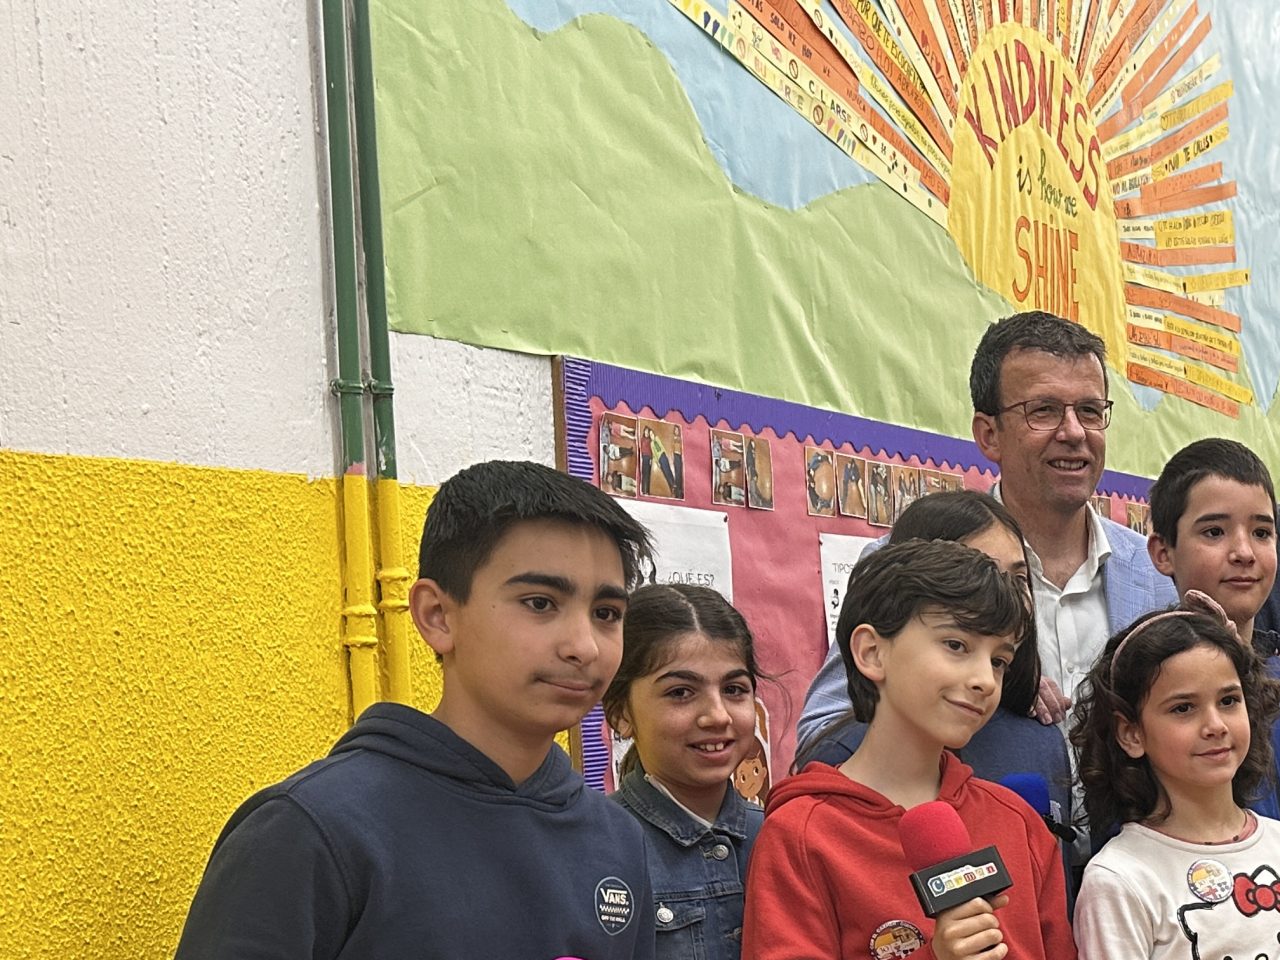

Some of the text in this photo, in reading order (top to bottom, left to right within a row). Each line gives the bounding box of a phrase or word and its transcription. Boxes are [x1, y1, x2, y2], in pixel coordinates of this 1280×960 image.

[964, 38, 1101, 212] KINDNESS
[1017, 155, 1033, 196] is
[1038, 148, 1063, 209] how
[600, 887, 628, 905] VANS
